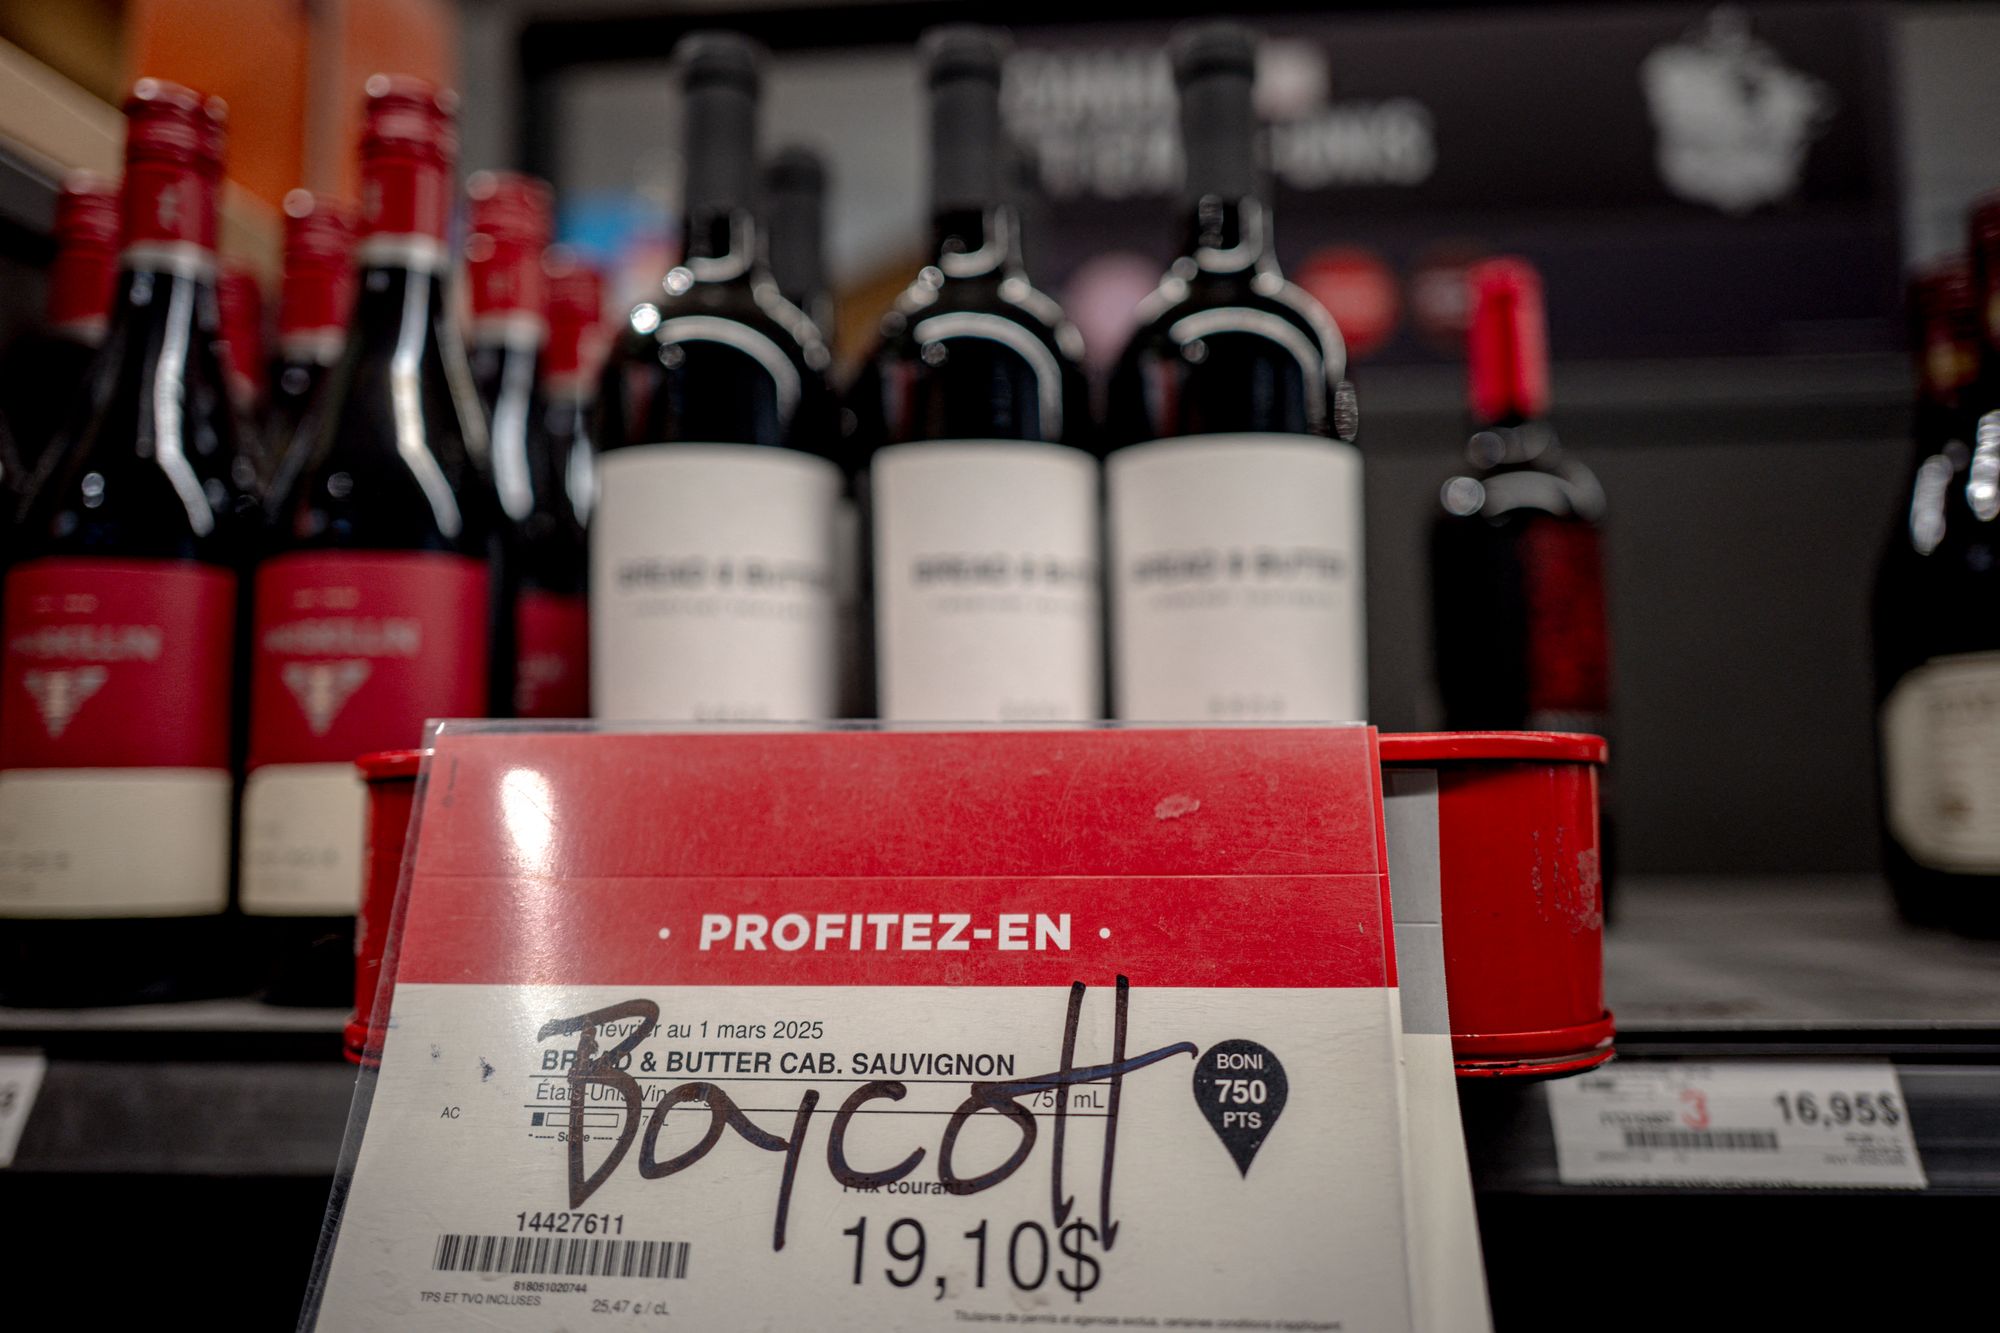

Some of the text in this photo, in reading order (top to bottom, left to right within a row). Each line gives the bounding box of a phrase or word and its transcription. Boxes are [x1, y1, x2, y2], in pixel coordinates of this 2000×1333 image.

[699, 913, 1071, 951] PROFITEZ-EN
[667, 1023, 691, 1039] au
[701, 1020, 708, 1038] 1
[717, 1023, 767, 1040] mars
[773, 1021, 823, 1040] 2025
[640, 1051, 657, 1072] &
[666, 1051, 772, 1073] BUTTER
[780, 1052, 843, 1074] CAB.
[852, 1052, 1015, 1076] SAUVIGNON
[1217, 1053, 1263, 1070] BONI
[1031, 1090, 1066, 1108] 750
[1074, 1089, 1105, 1108] mL
[1215, 1079, 1266, 1104] 750
[441, 1107, 460, 1119] AC
[537, 974, 1199, 1252] Boycott
[1680, 1088, 1901, 1130] 3 16,95$
[1223, 1111, 1263, 1129] PTS
[842, 1175, 881, 1194] Prix
[516, 1211, 624, 1235] 14427611
[842, 1215, 1102, 1301] 19,10$
[420, 1291, 541, 1306] TPS ET TVQ INCLUSES
[592, 1299, 630, 1314] 25,47
